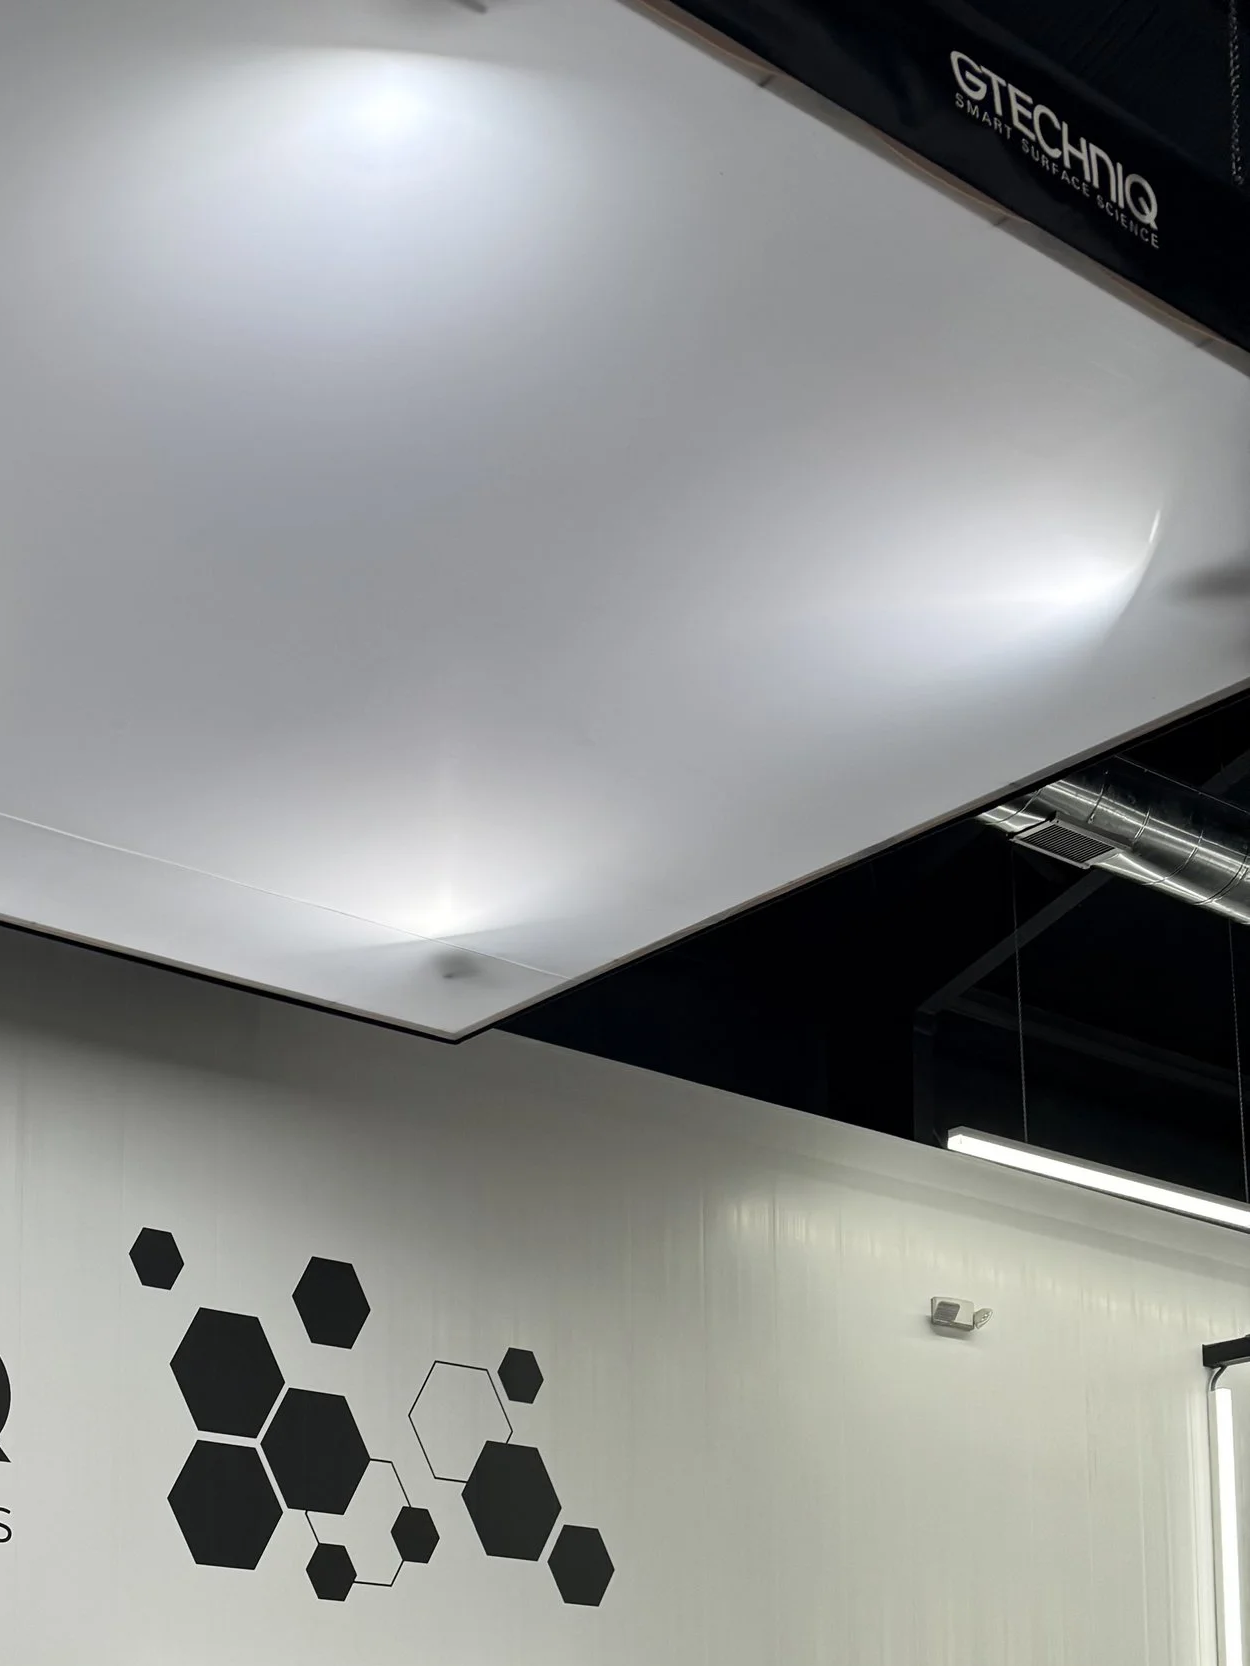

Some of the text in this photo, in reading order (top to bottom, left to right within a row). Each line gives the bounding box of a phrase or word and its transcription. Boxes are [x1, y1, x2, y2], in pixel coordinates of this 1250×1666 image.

[950, 50, 1158, 230] GTECHNIQ
[954, 92, 1159, 249] SMART SURFACE SCIENCE
